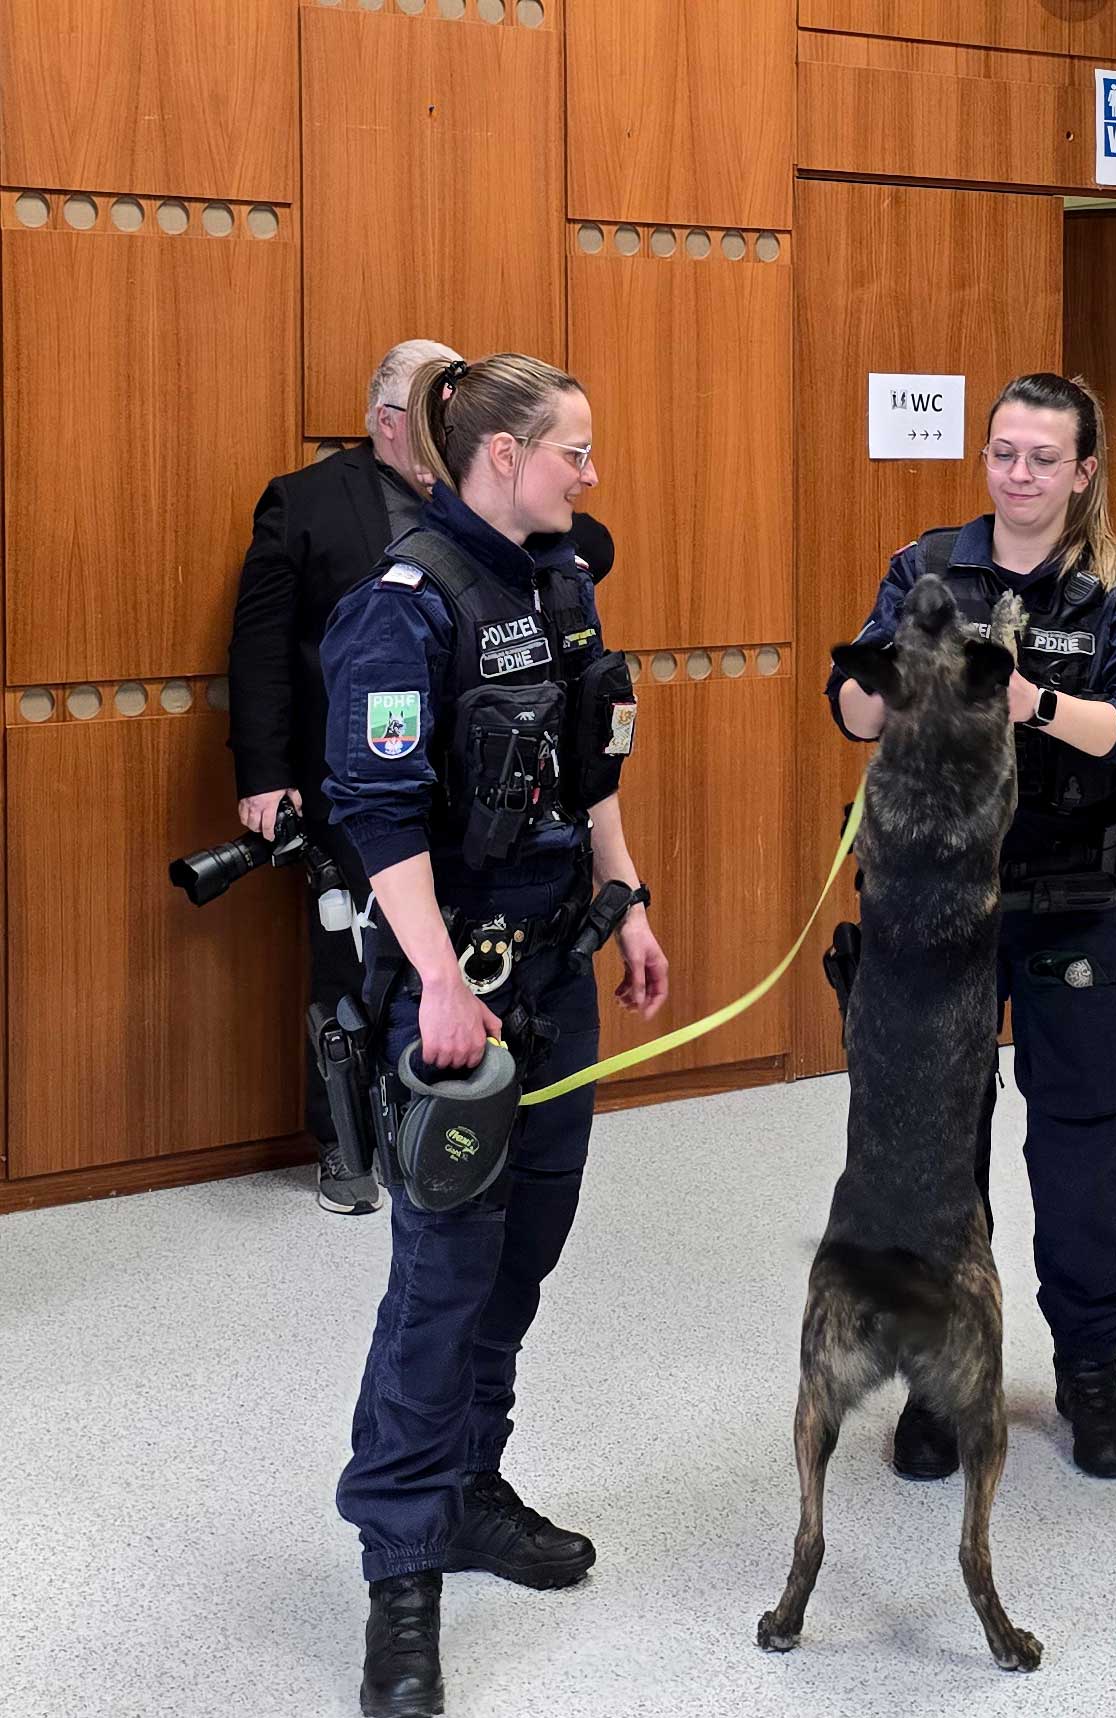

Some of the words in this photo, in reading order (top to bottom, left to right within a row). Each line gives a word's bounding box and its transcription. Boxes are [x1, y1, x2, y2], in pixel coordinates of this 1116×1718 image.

[911, 393, 943, 412] WC
[481, 615, 538, 650] POLIZEI
[1034, 635, 1080, 652] PDHE
[497, 650, 534, 673] PDHE
